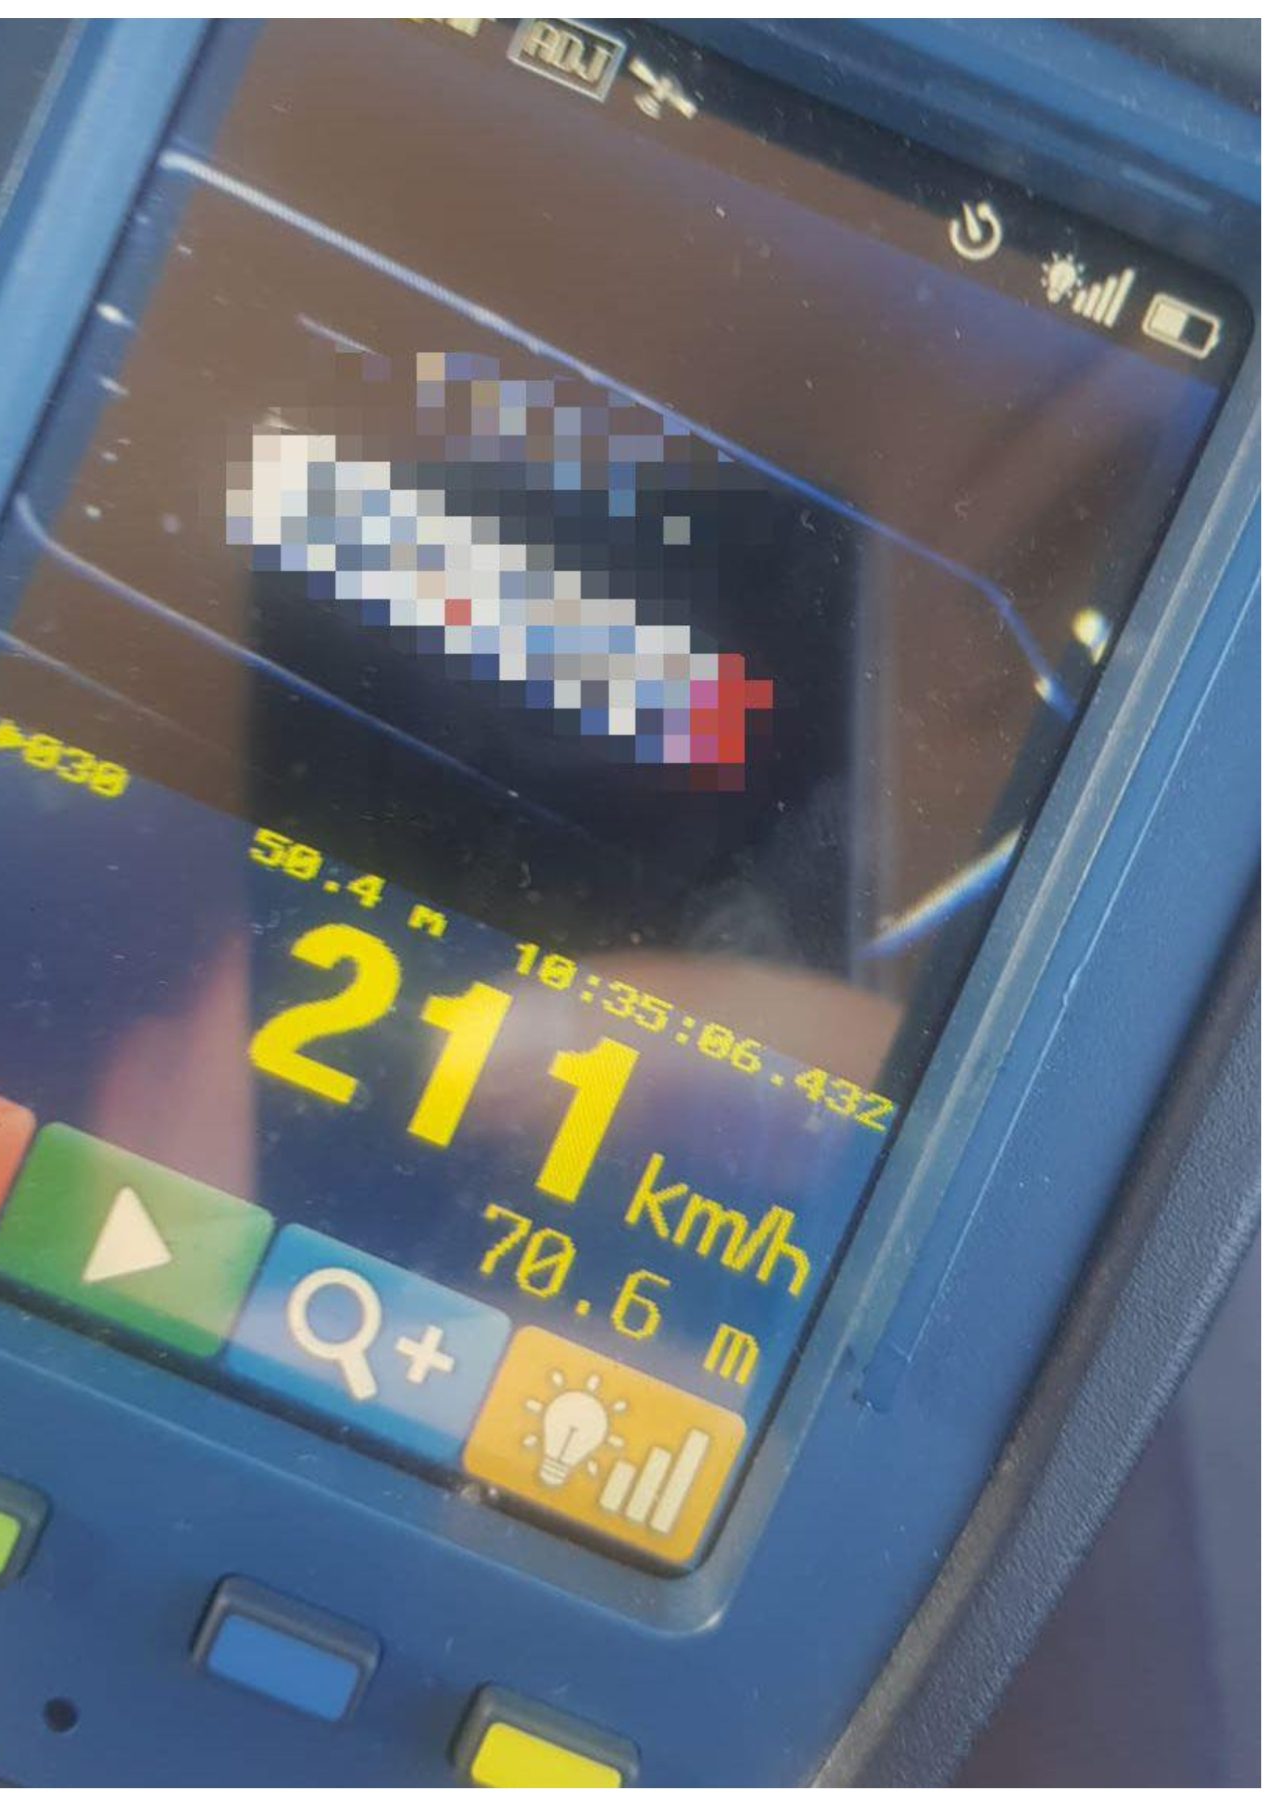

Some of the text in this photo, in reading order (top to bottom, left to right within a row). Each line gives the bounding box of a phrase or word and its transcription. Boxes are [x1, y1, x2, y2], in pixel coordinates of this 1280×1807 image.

[520, 21, 613, 84] ADJ
[249, 828, 895, 1132] 50.4 m 10:35:06.432
[247, 923, 813, 1298] 211 km/h
[479, 1204, 759, 1386] 70.6 m
